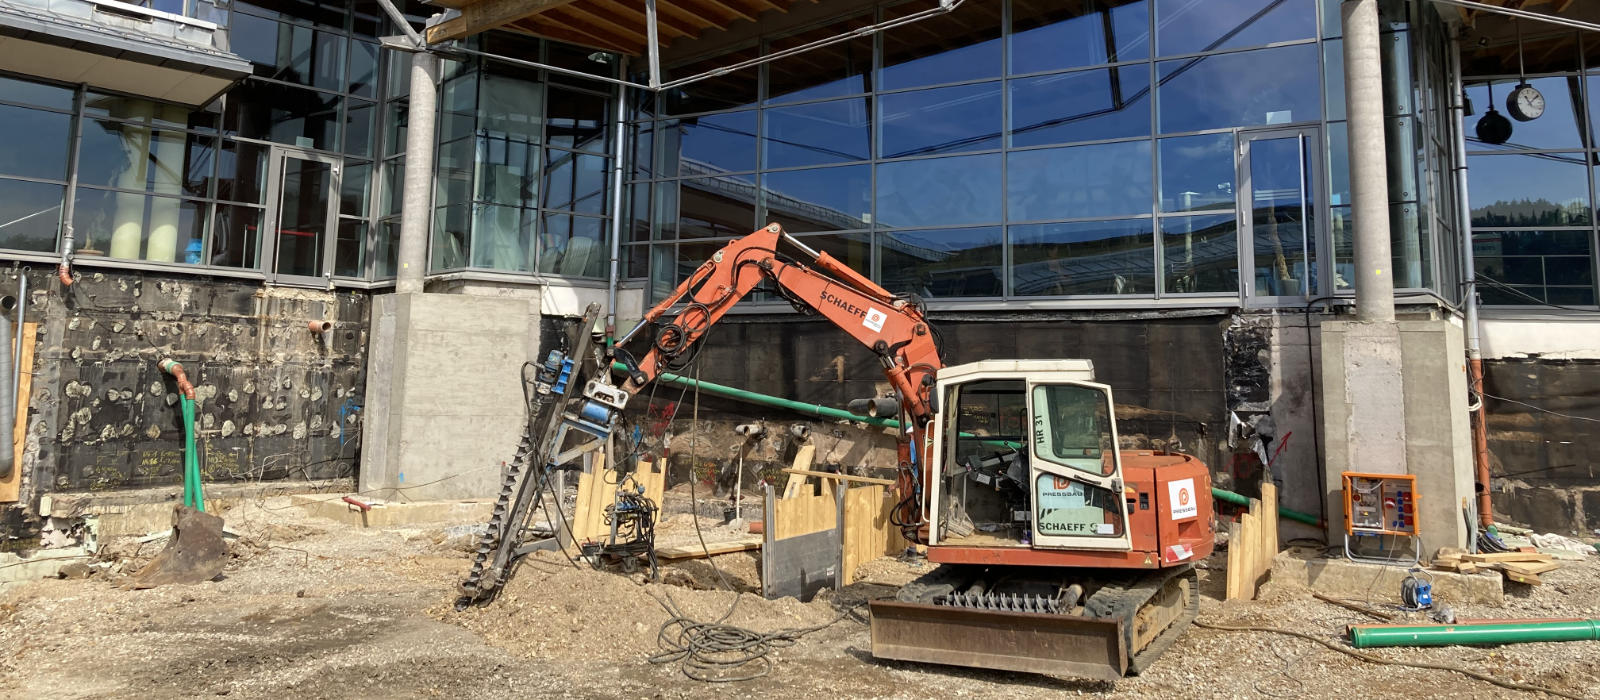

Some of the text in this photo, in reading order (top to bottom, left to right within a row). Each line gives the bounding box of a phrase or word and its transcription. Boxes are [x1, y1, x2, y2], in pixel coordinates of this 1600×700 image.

[820, 290, 867, 319] SCHAEFF
[1035, 415, 1045, 444] HR 31
[1039, 522, 1086, 532] SCHAEFF
